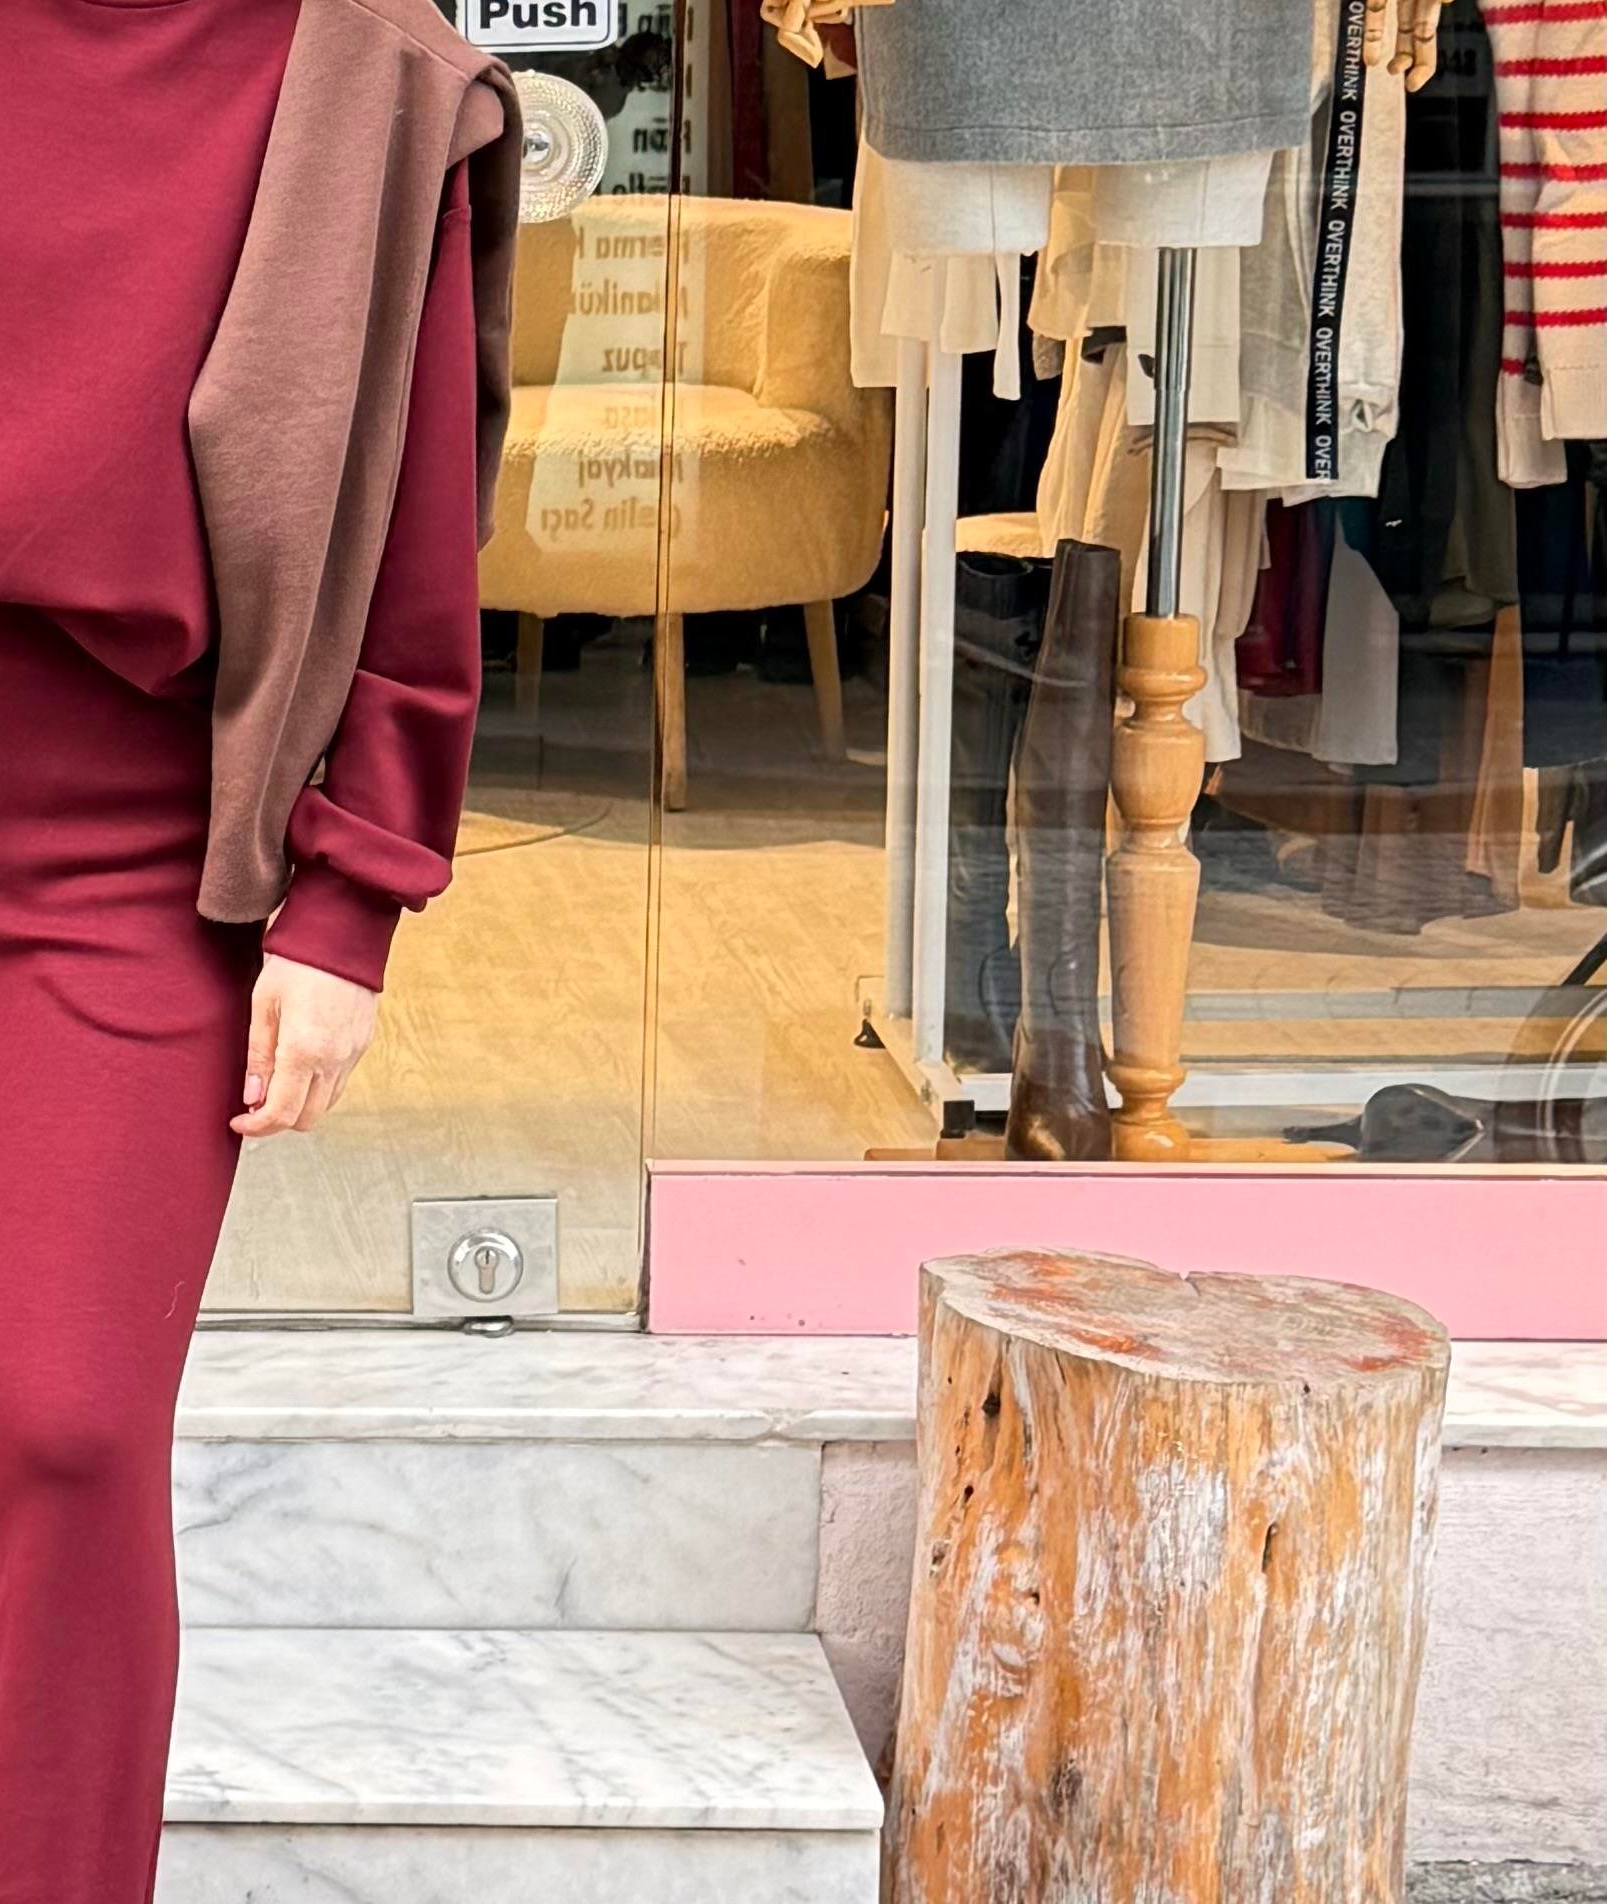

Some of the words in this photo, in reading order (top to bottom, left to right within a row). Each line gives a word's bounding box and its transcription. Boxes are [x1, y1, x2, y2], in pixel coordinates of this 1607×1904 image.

[1341, 1, 1364, 101] OVERTHINK
[1330, 111, 1356, 210] OVERTHINK
[1318, 219, 1344, 318] OVERTHINK
[1314, 327, 1332, 426] OVERTHINK
